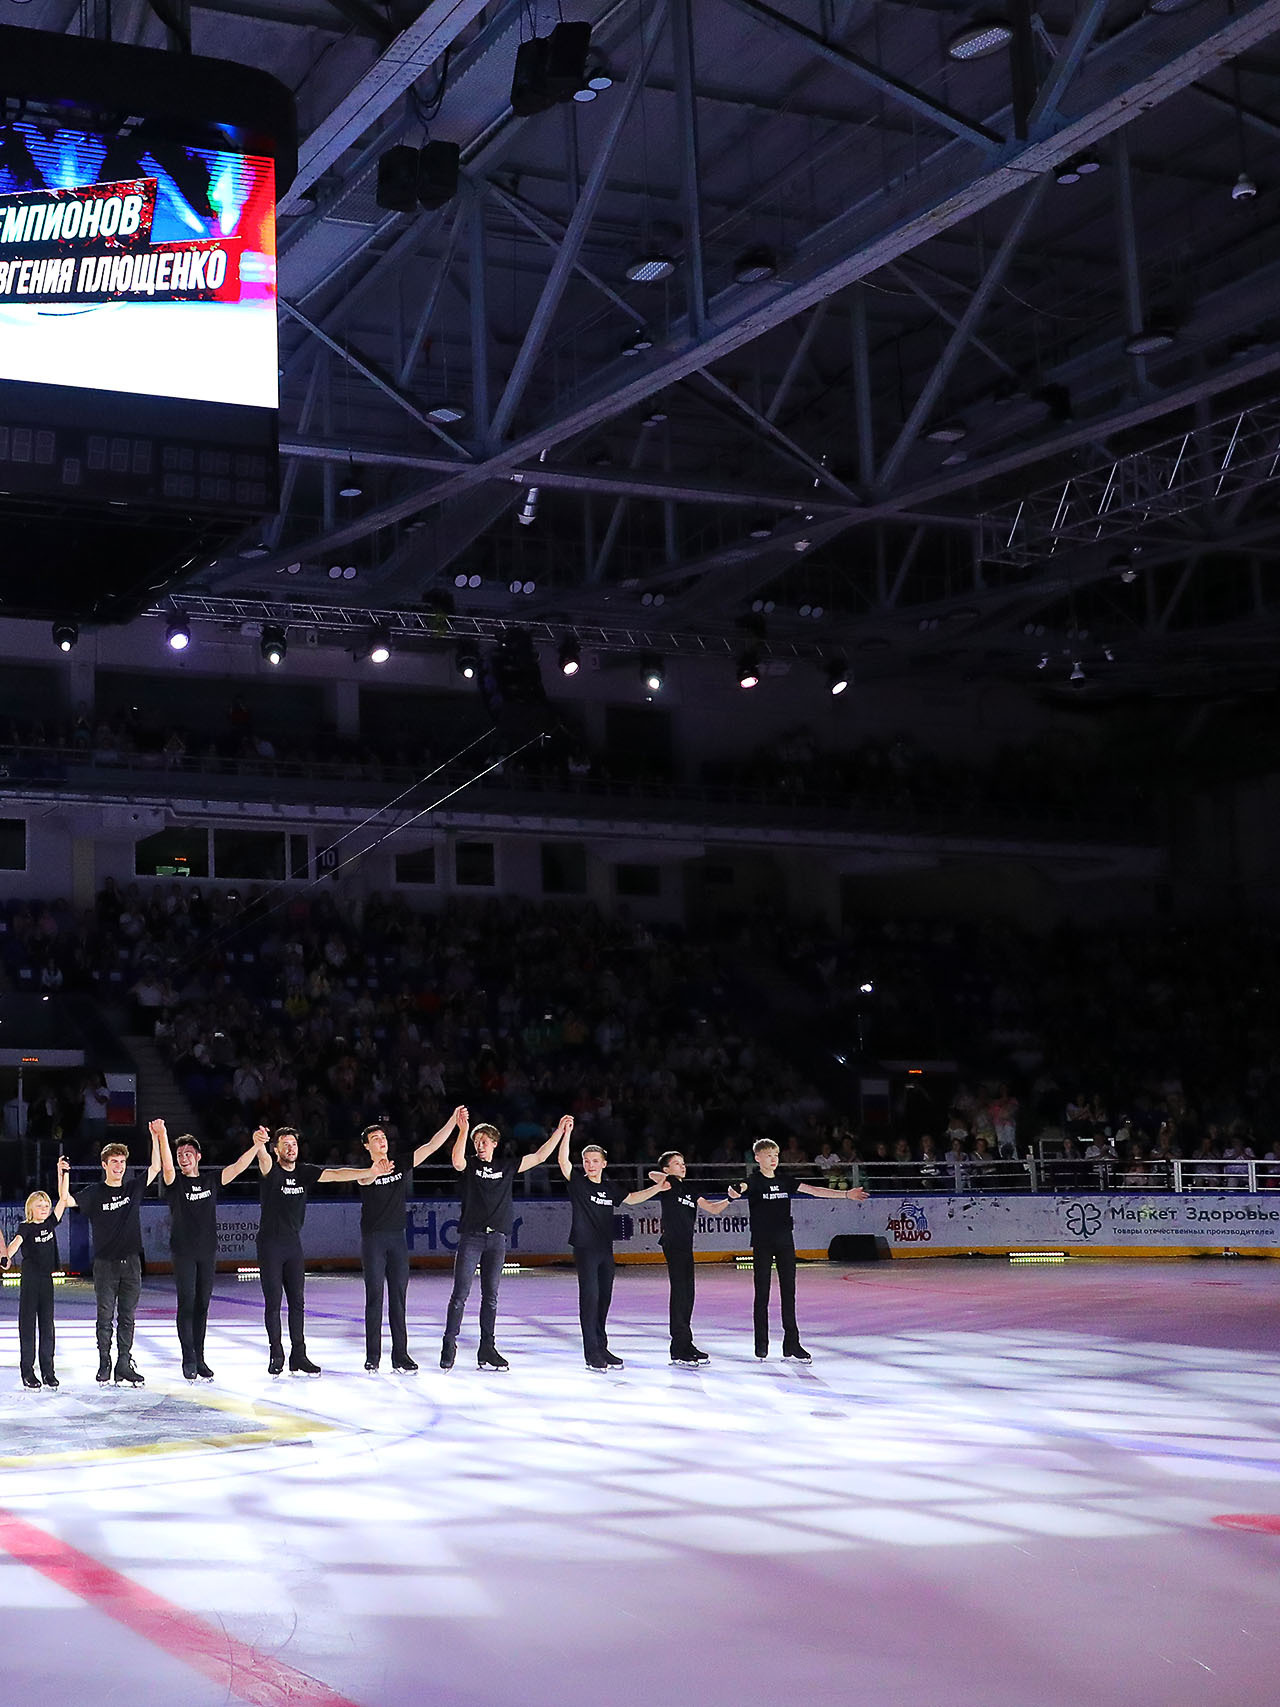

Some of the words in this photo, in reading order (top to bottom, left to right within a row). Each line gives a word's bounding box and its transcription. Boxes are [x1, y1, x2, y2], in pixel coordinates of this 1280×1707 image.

[78, 249, 228, 295] ПЛЮЩЕНКО
[322, 850, 336, 867] 10
[1111, 1207, 1177, 1223] Маркет
[1186, 1207, 1280, 1223] Здоровье
[886, 1219, 915, 1231] АВТО
[1112, 1227, 1143, 1236] Товары
[1144, 1228, 1204, 1236] отечественных
[1206, 1227, 1275, 1237] производителей
[894, 1230, 931, 1242] РАДИО
